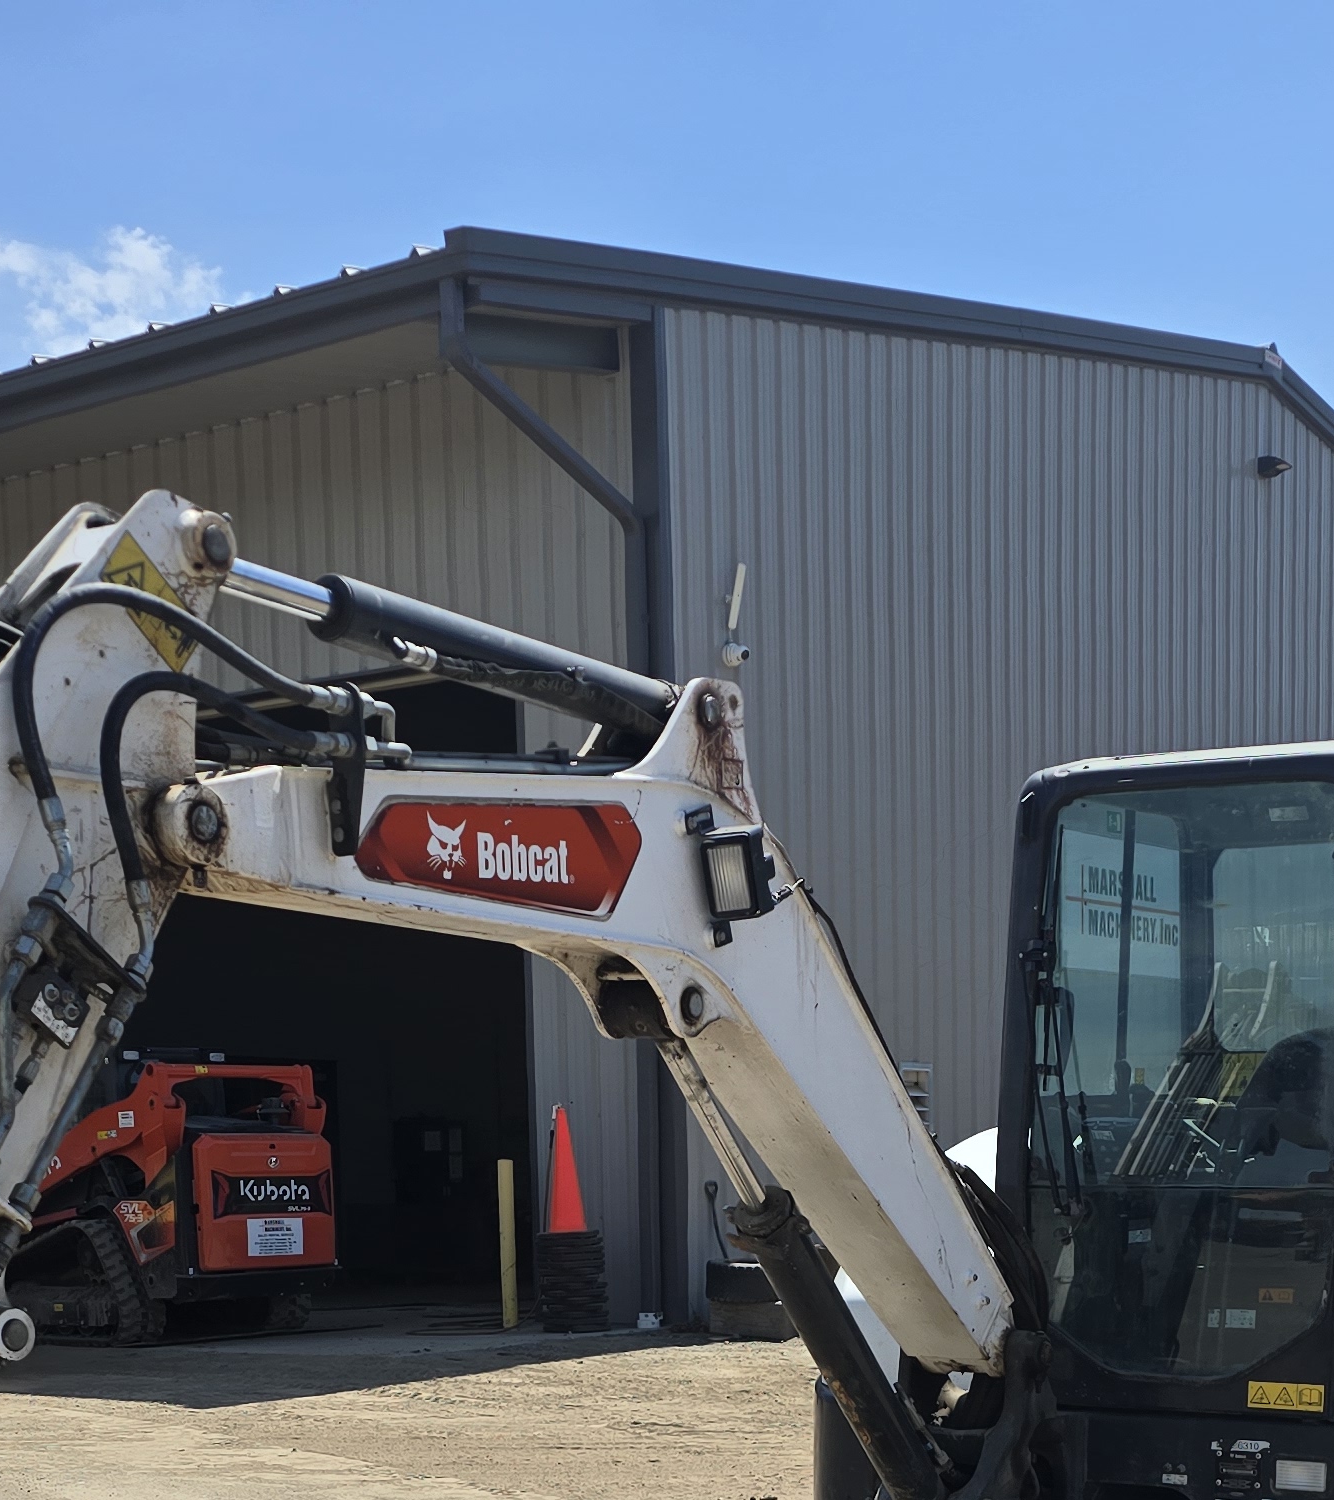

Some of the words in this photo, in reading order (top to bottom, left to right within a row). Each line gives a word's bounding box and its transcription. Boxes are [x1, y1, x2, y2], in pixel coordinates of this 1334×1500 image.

[476, 831, 569, 884] Bobcat
[1088, 865, 1157, 903] MARSALL
[239, 1179, 310, 1201] Kubota
[120, 1203, 143, 1214] SVL
